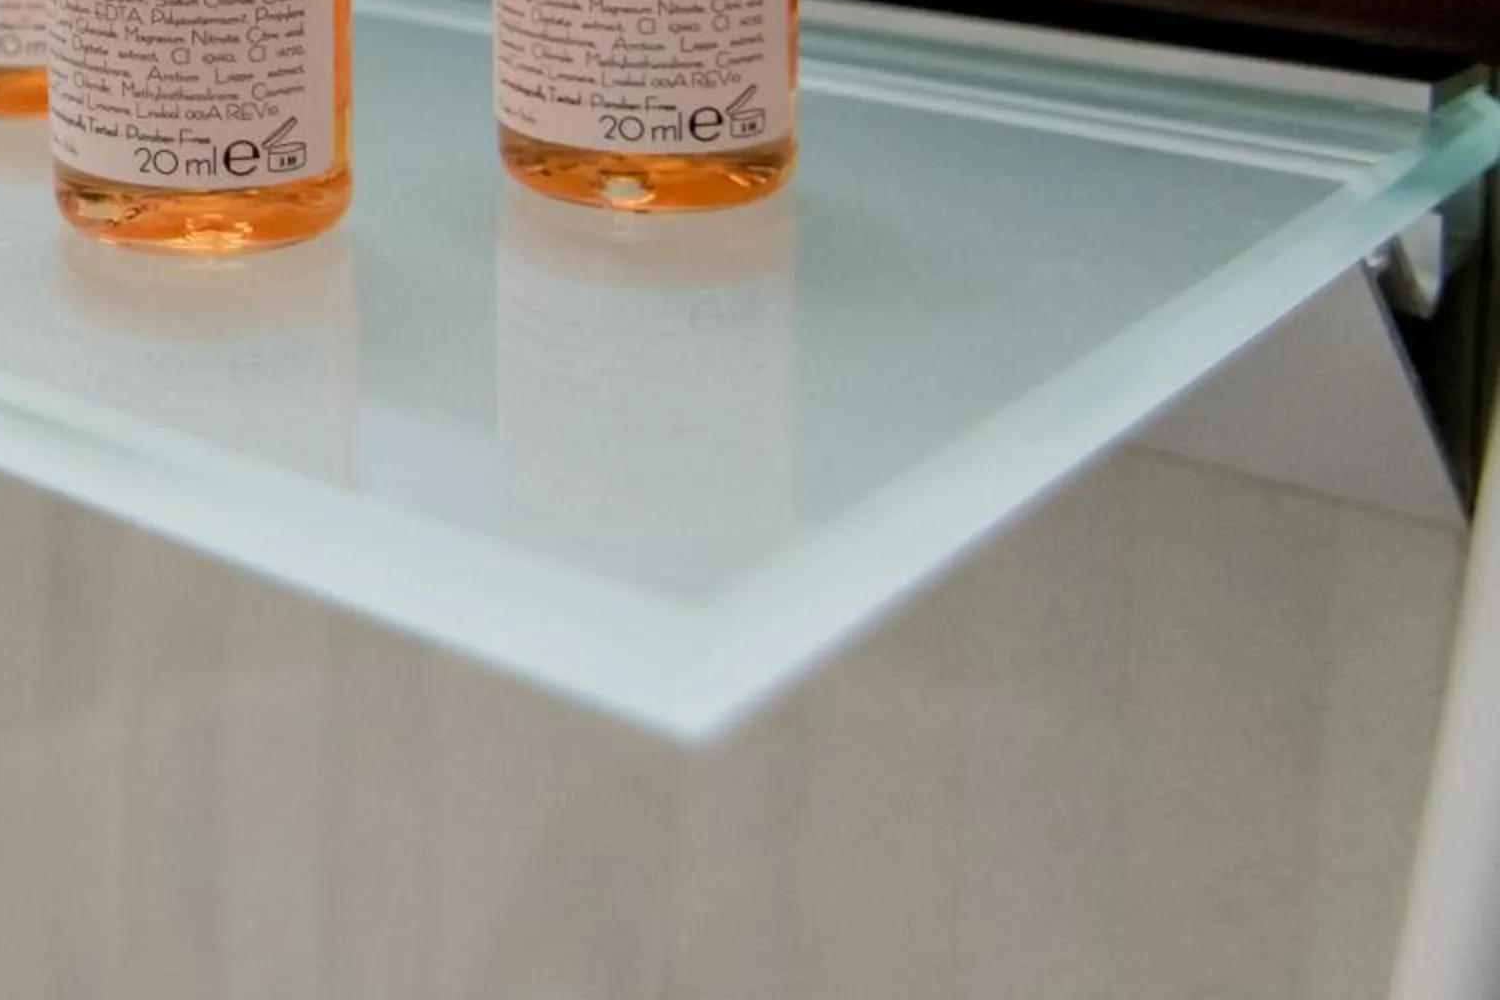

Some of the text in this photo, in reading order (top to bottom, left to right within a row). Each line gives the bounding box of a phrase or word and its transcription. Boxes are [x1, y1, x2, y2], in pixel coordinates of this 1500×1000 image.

[600, 114, 645, 142] 20
[651, 112, 683, 142] ml
[688, 106, 724, 142] e
[134, 140, 261, 176] 20 ml e
